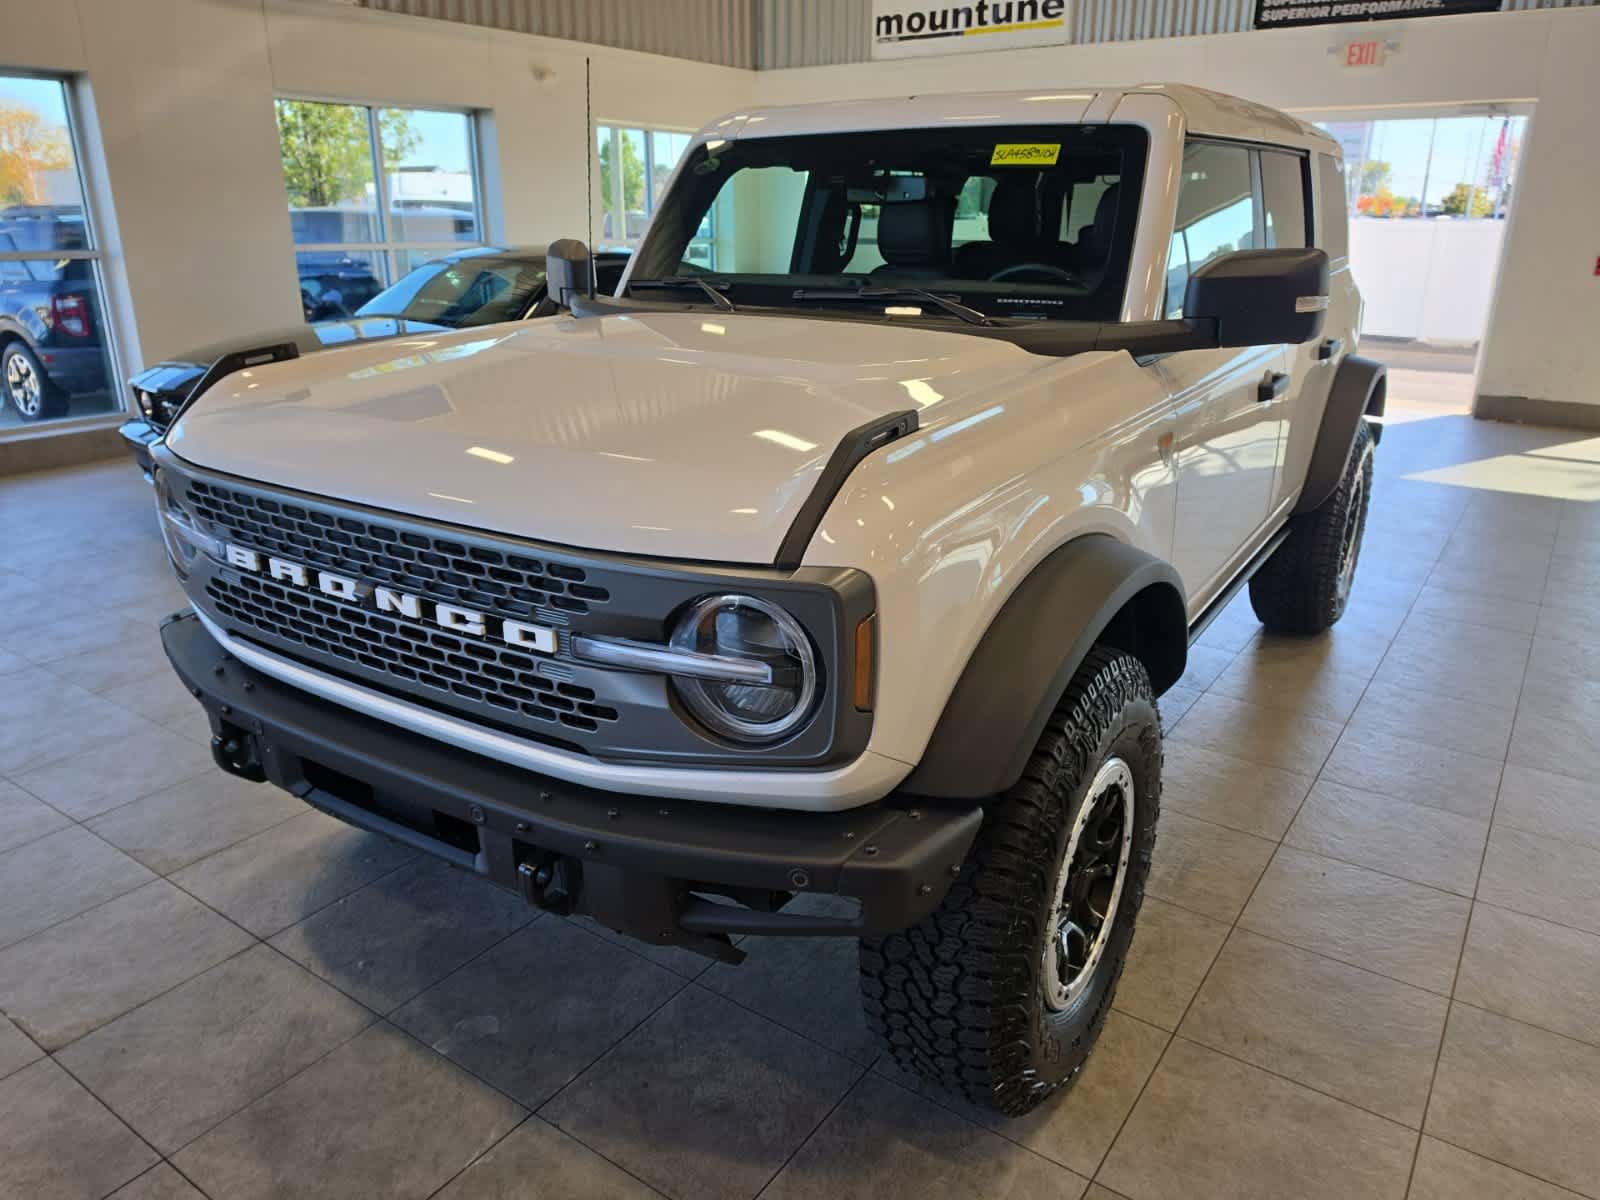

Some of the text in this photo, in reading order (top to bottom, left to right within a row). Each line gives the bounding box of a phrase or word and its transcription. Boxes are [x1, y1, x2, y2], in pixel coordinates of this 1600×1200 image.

[876, 0, 1065, 36] mountune
[1260, 0, 1445, 22] SUPERIOR PERFORMANCE.
[1346, 41, 1377, 66] EXIT
[226, 544, 557, 653] BRONCO
